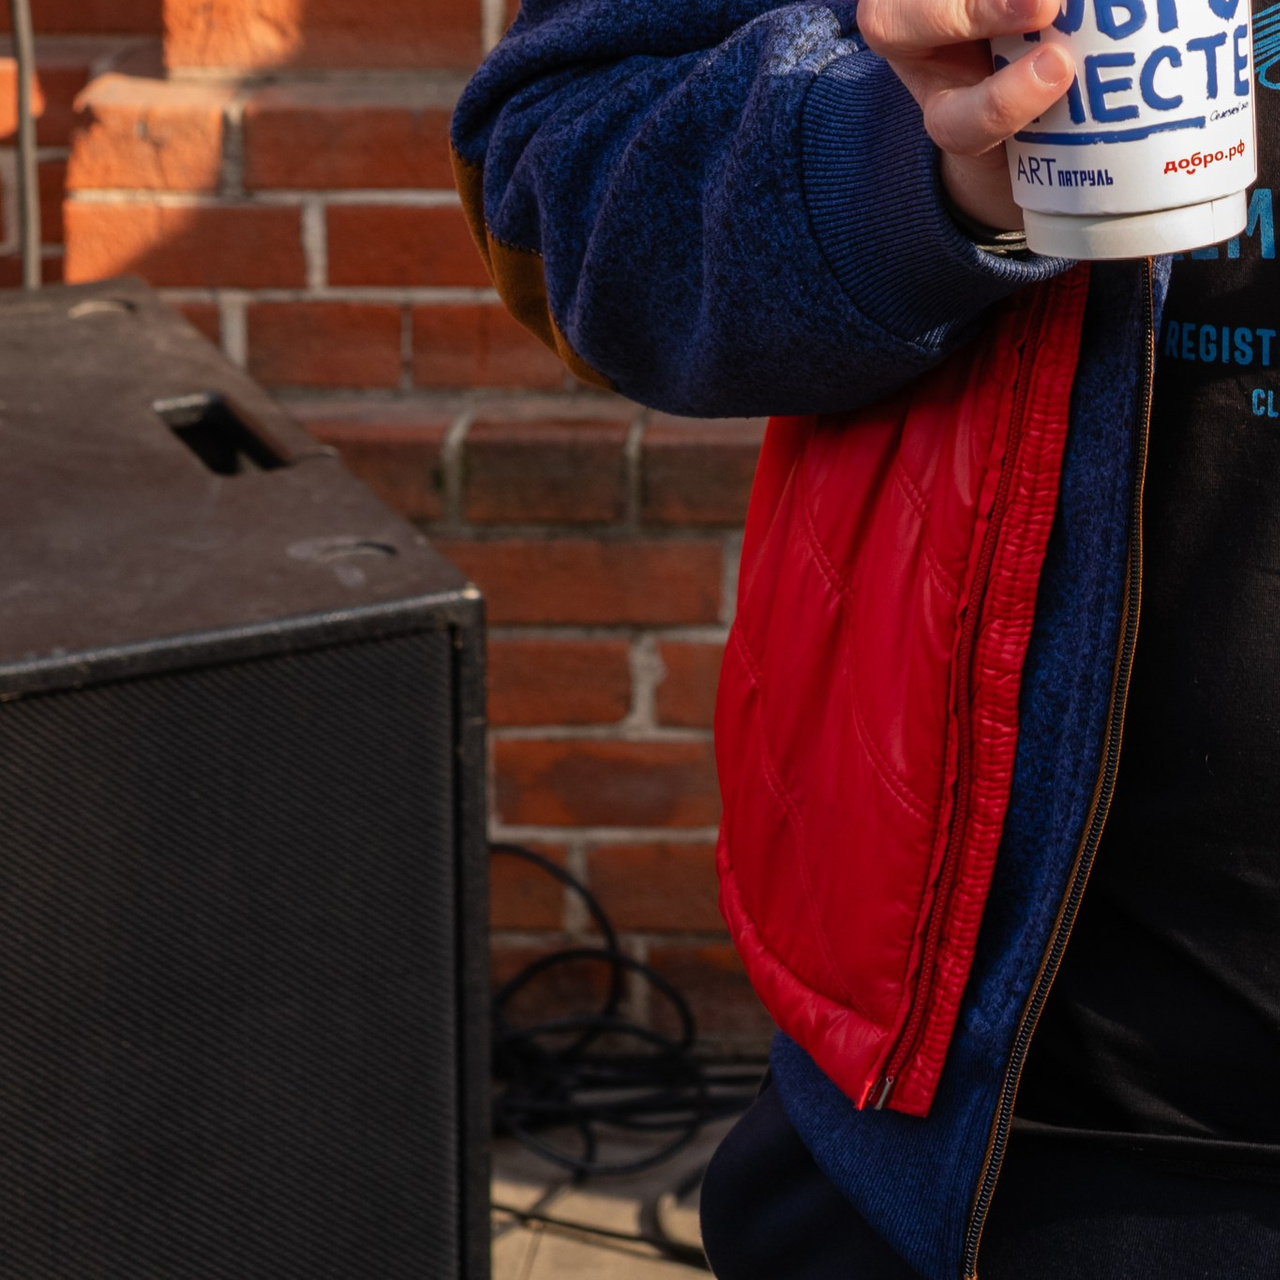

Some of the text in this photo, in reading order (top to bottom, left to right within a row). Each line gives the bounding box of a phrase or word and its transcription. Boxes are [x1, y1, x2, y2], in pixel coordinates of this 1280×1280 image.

[994, 24, 1250, 125] ЕСТЕ
[1163, 139, 1245, 175] добро.рф
[1058, 169, 1114, 187] ПАТРУЛЬ
